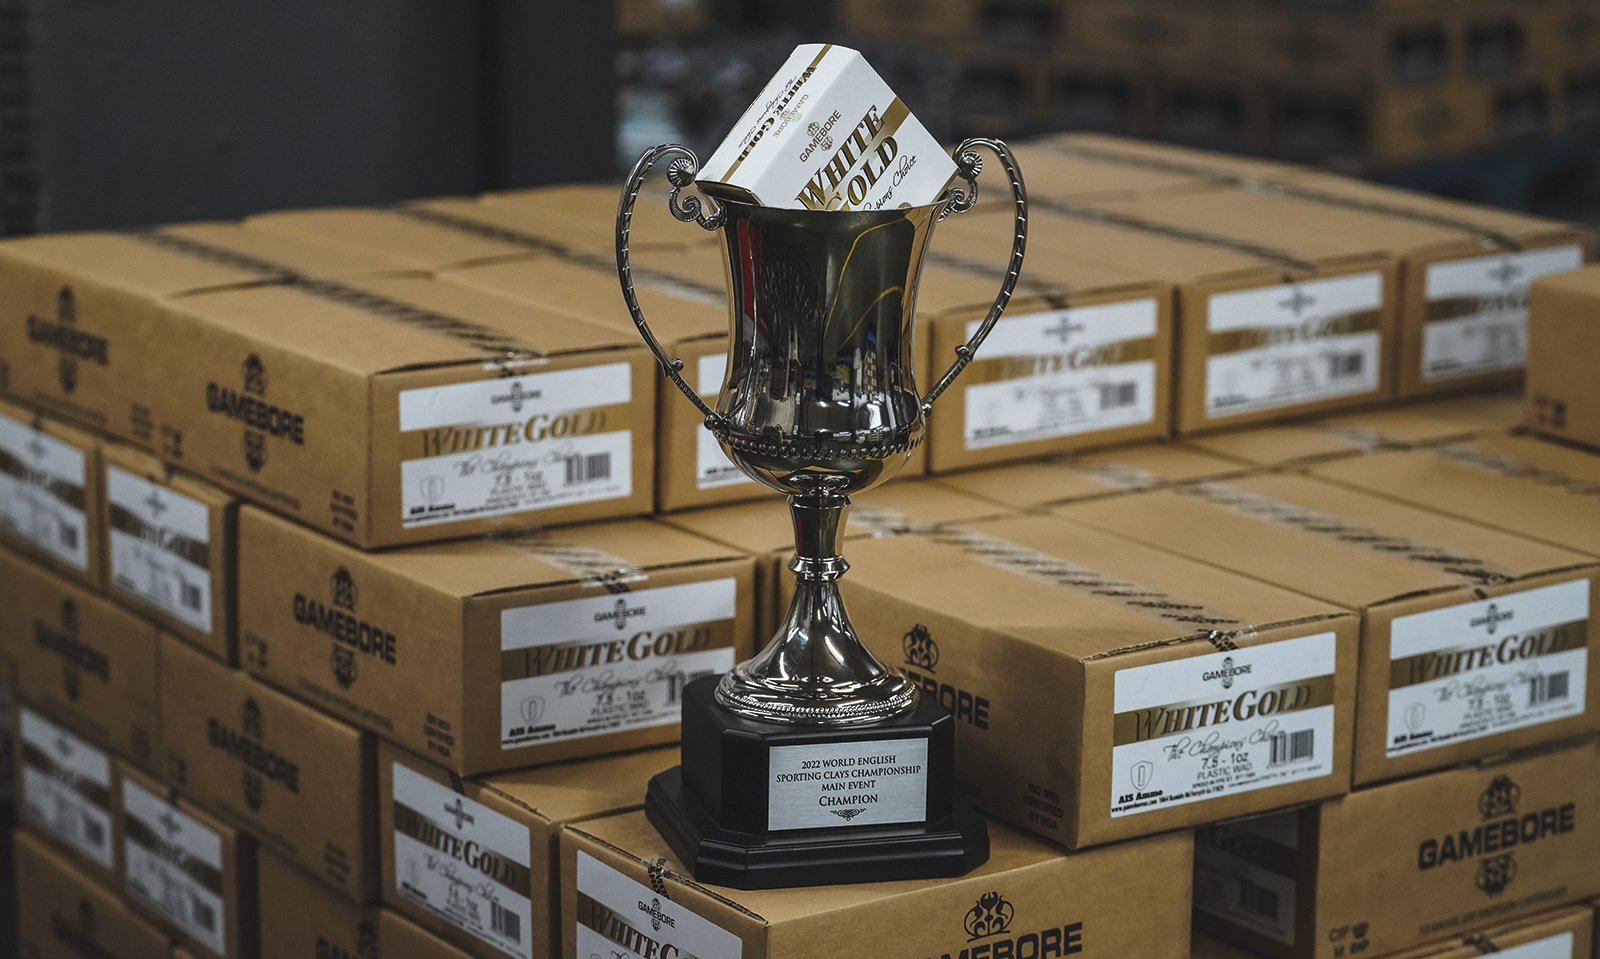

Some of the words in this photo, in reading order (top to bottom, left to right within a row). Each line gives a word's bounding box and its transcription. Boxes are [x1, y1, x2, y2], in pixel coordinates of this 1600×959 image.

[773, 66, 817, 116] WHITE
[773, 94, 809, 138] GAMEBORE
[738, 117, 775, 163] GOLD
[799, 110, 842, 163] GAMEBORE
[795, 104, 885, 210] WHITE
[893, 155, 917, 187] Choice
[293, 591, 397, 666] GAMEBORE
[594, 606, 647, 622] GAMEBORE
[1202, 664, 1253, 682] GAMEBORE
[898, 667, 989, 731] BORE
[776, 770, 822, 783] SPORTING
[823, 770, 850, 780] CLAYS
[851, 765, 921, 778] CHAMPIONSHIP
[801, 760, 821, 770] 2022
[822, 757, 856, 768] WORLD
[857, 755, 897, 766] ENGLISH
[1197, 764, 1231, 780] PLASTIC
[1233, 762, 1253, 773] WAD
[1202, 756, 1219, 770] 7.5
[818, 794, 879, 807] CHAMPION
[821, 782, 846, 792] MAIN
[848, 780, 876, 790] EVENT
[1118, 793, 1133, 804] AIS
[1136, 790, 1163, 800] Ammo
[1418, 804, 1575, 871] GAMEBORE
[637, 900, 676, 929] GAMEBORE
